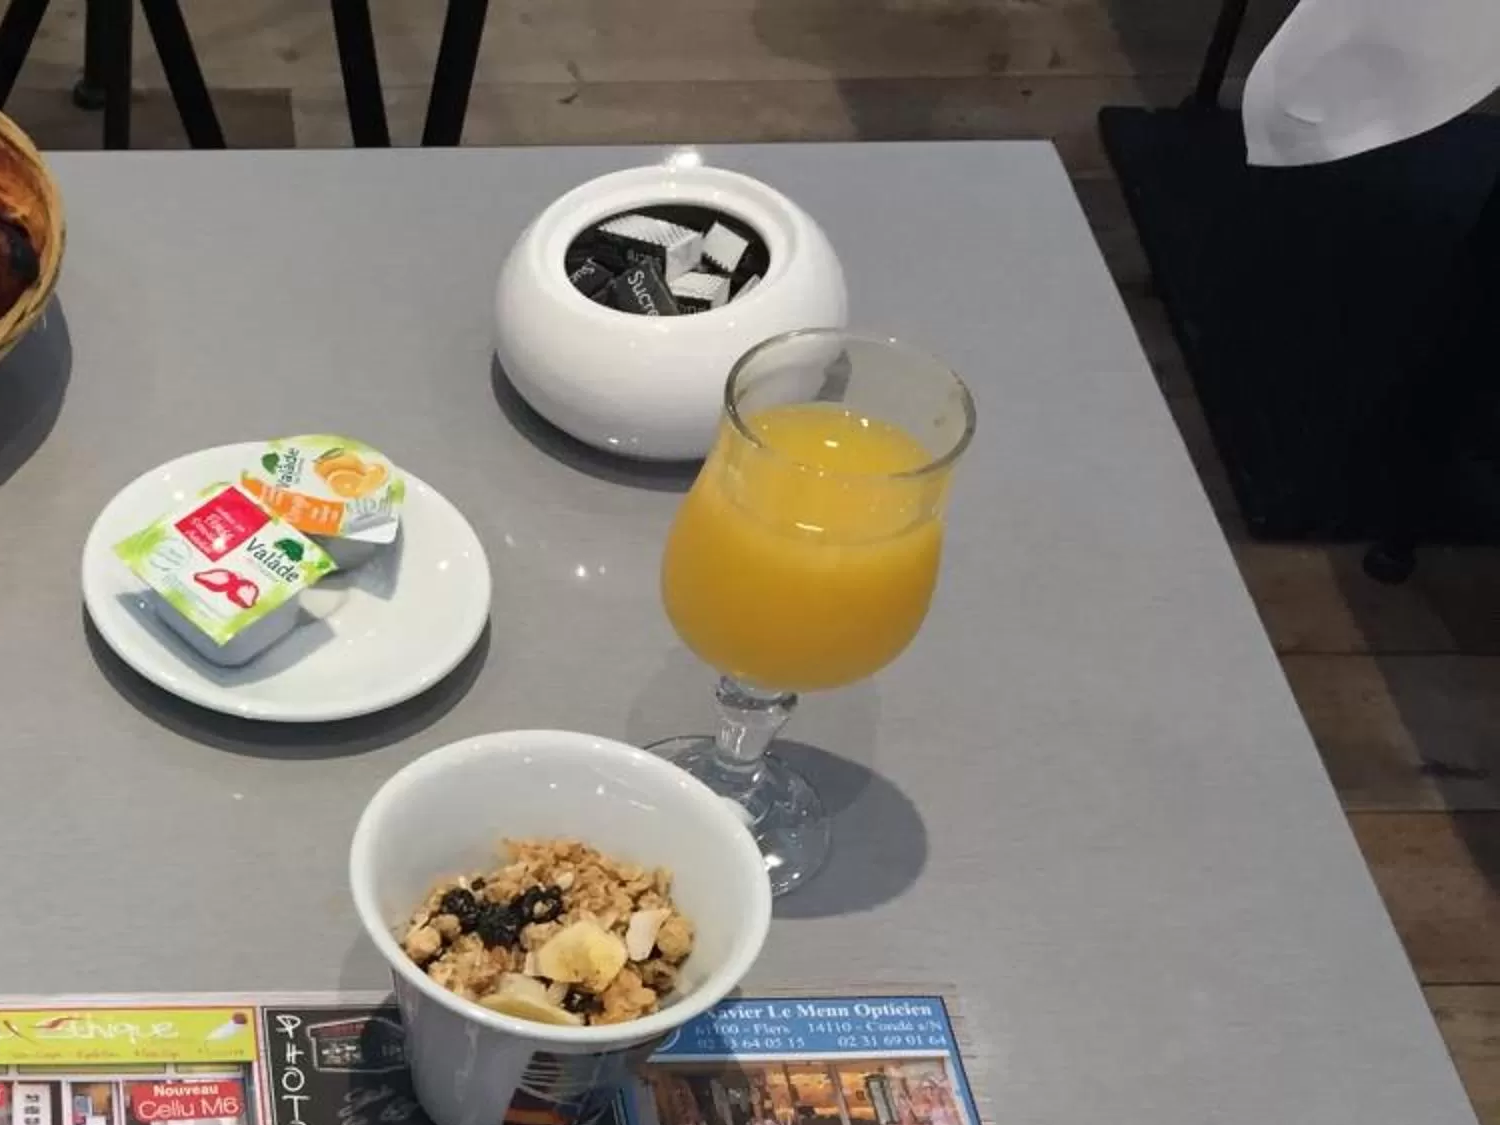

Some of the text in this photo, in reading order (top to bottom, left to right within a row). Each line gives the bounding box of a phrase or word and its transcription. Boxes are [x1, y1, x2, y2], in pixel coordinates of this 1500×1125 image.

[627, 269, 661, 316] Sucre
[245, 537, 301, 583] Valade
[767, 1003, 792, 1019] Le
[796, 1003, 849, 1018] Menn
[854, 1002, 932, 1020] Opticien
[753, 1022, 791, 1035] Flers
[837, 1035, 857, 1048] 02
[152, 1084, 219, 1097] Nouveau
[136, 1098, 240, 1119] Cellu M6
